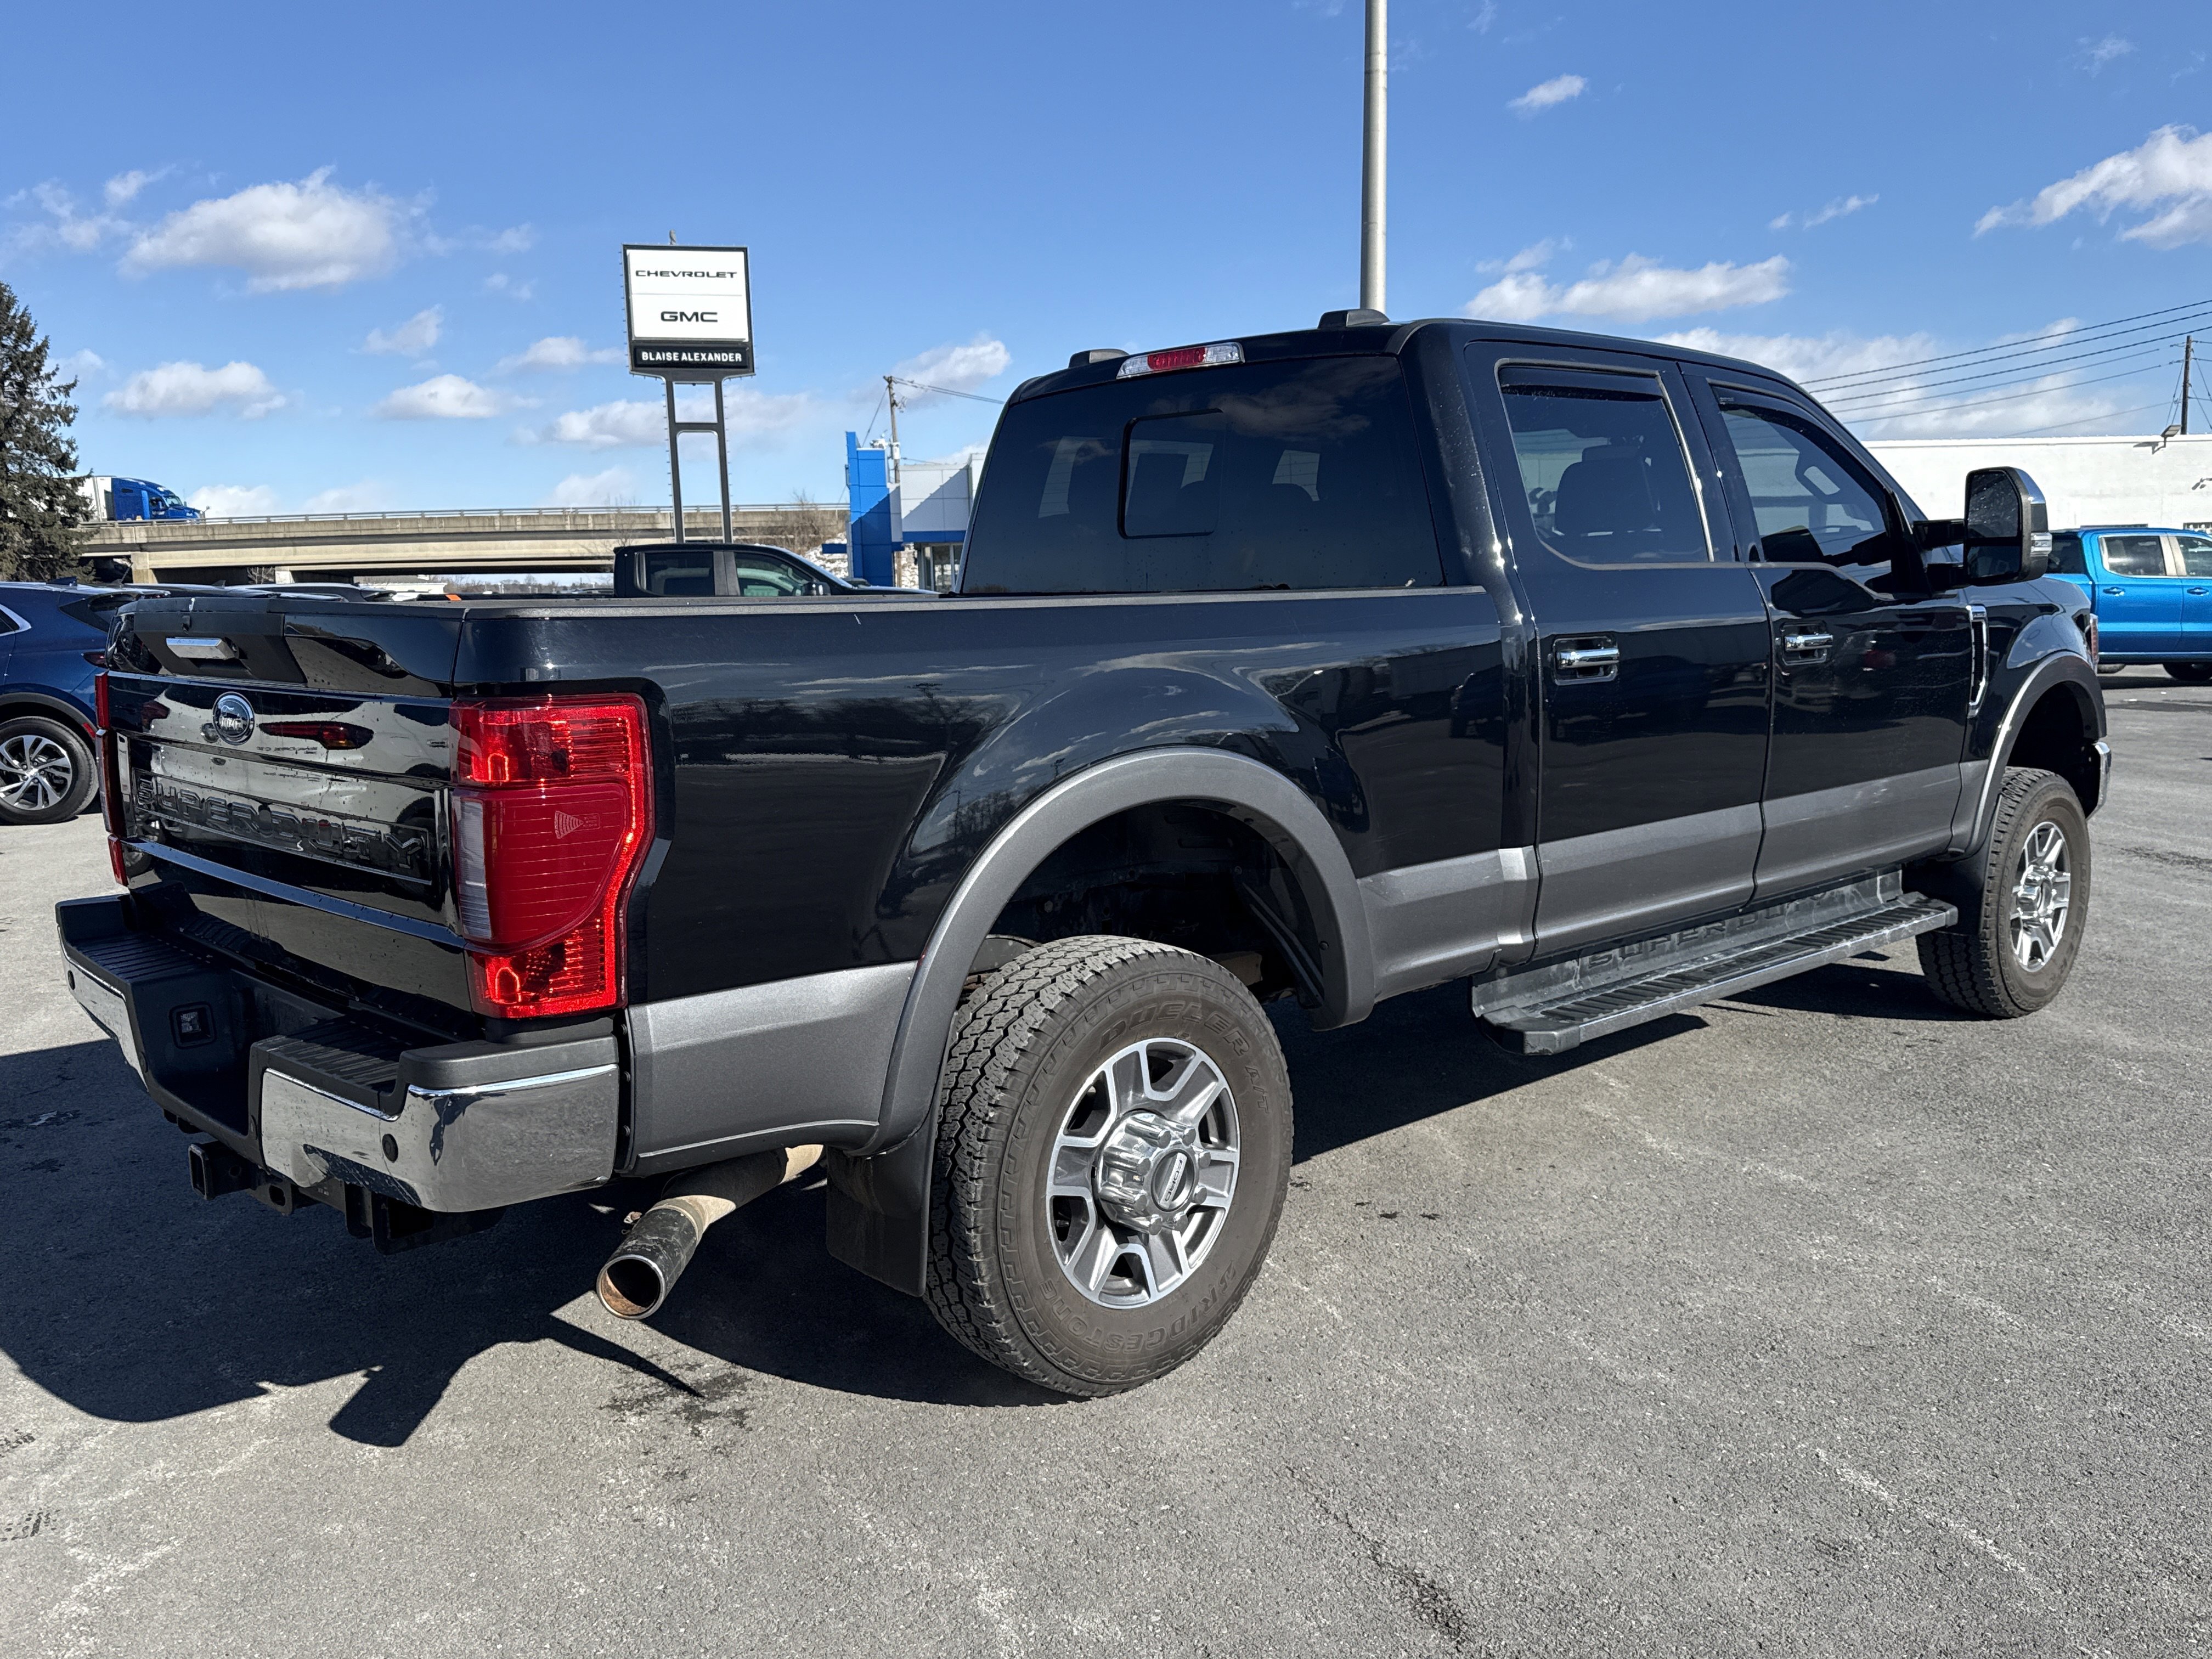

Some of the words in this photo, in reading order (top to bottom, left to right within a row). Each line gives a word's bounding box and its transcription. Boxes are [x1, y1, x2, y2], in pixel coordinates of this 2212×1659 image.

[635, 270, 737, 278] CHEVROLET
[661, 311, 718, 322] GMC
[642, 351, 679, 361] BLAISE
[681, 352, 742, 362] ALEXANDER
[138, 776, 261, 834] SUPER
[263, 810, 426, 870] DUTY
[1098, 1000, 1250, 1057] DUELER
[1244, 1065, 1269, 1114] A/T
[1165, 1159, 1183, 1202] FORD
[1039, 1260, 1237, 1354] BRIDGESTONE
